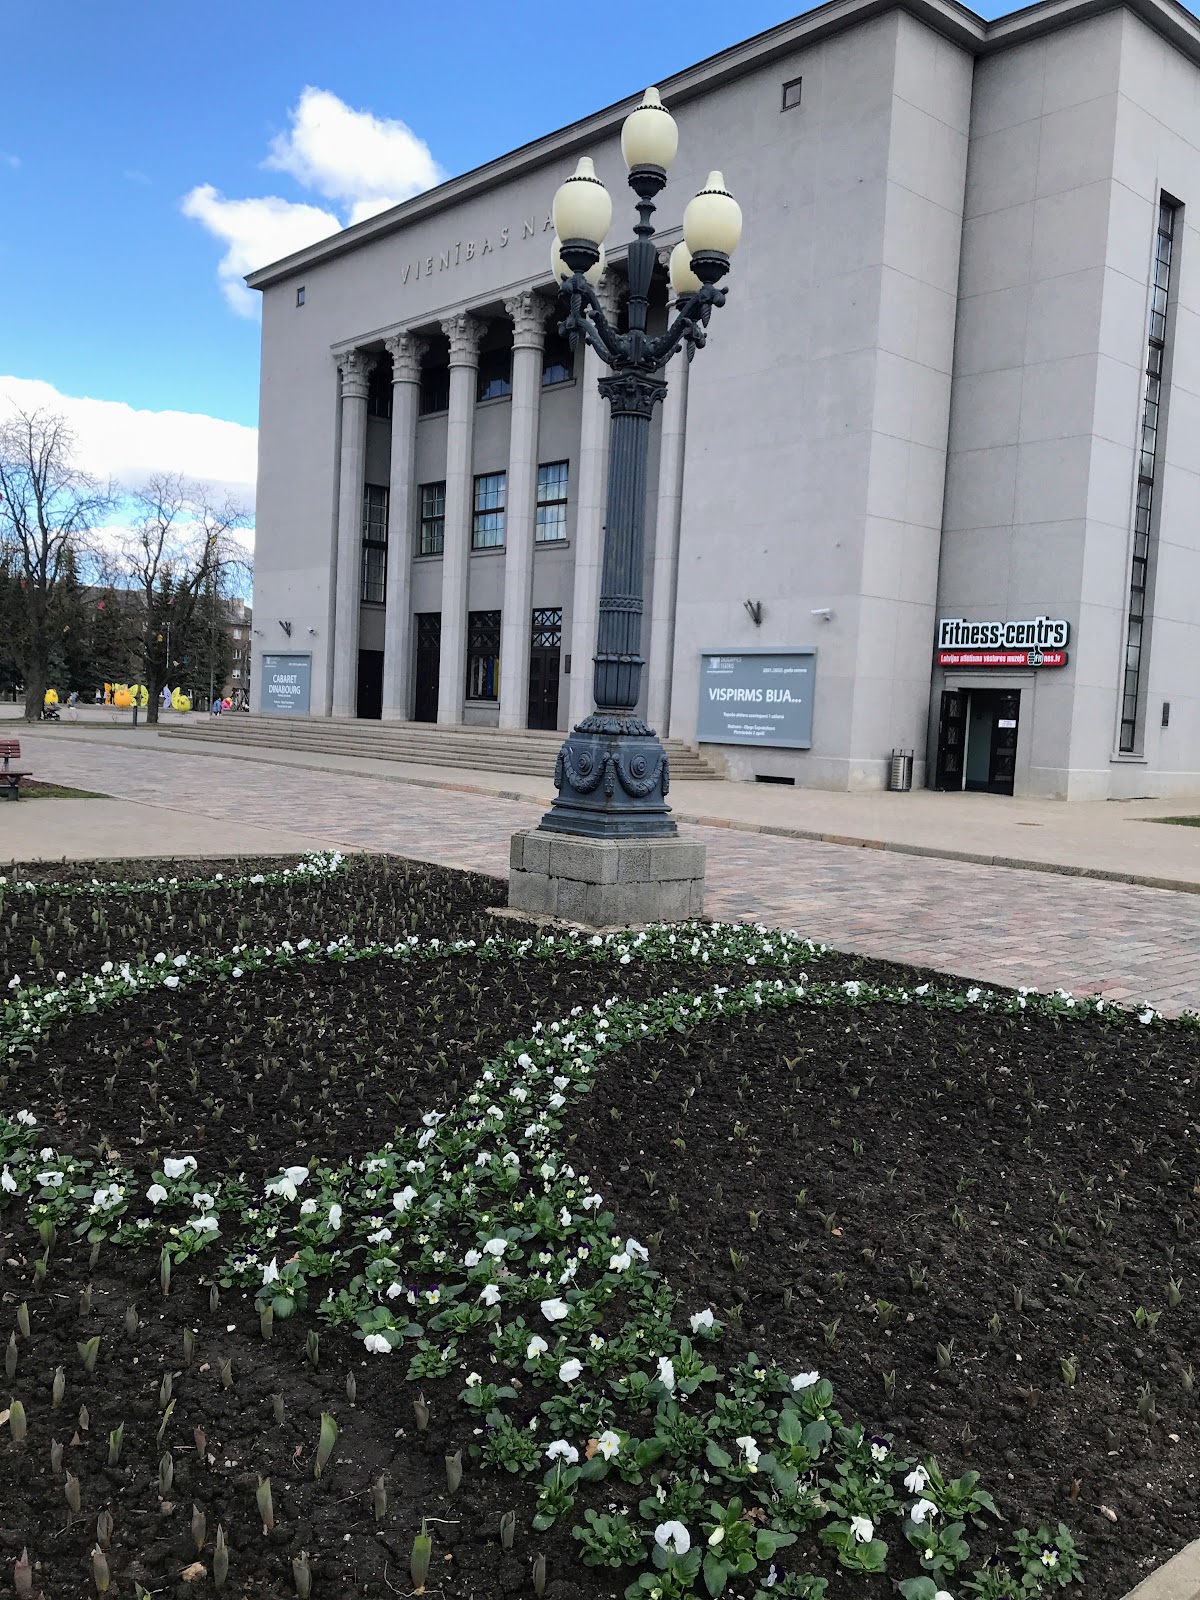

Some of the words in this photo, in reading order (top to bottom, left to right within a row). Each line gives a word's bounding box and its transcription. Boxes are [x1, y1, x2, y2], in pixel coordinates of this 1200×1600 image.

[401, 227, 509, 285] VIENĪBAS
[522, 210, 554, 240] NA
[941, 620, 1065, 645] Fitness-centrs
[273, 674, 297, 684] CABARET
[708, 687, 763, 702] VISPIRMS
